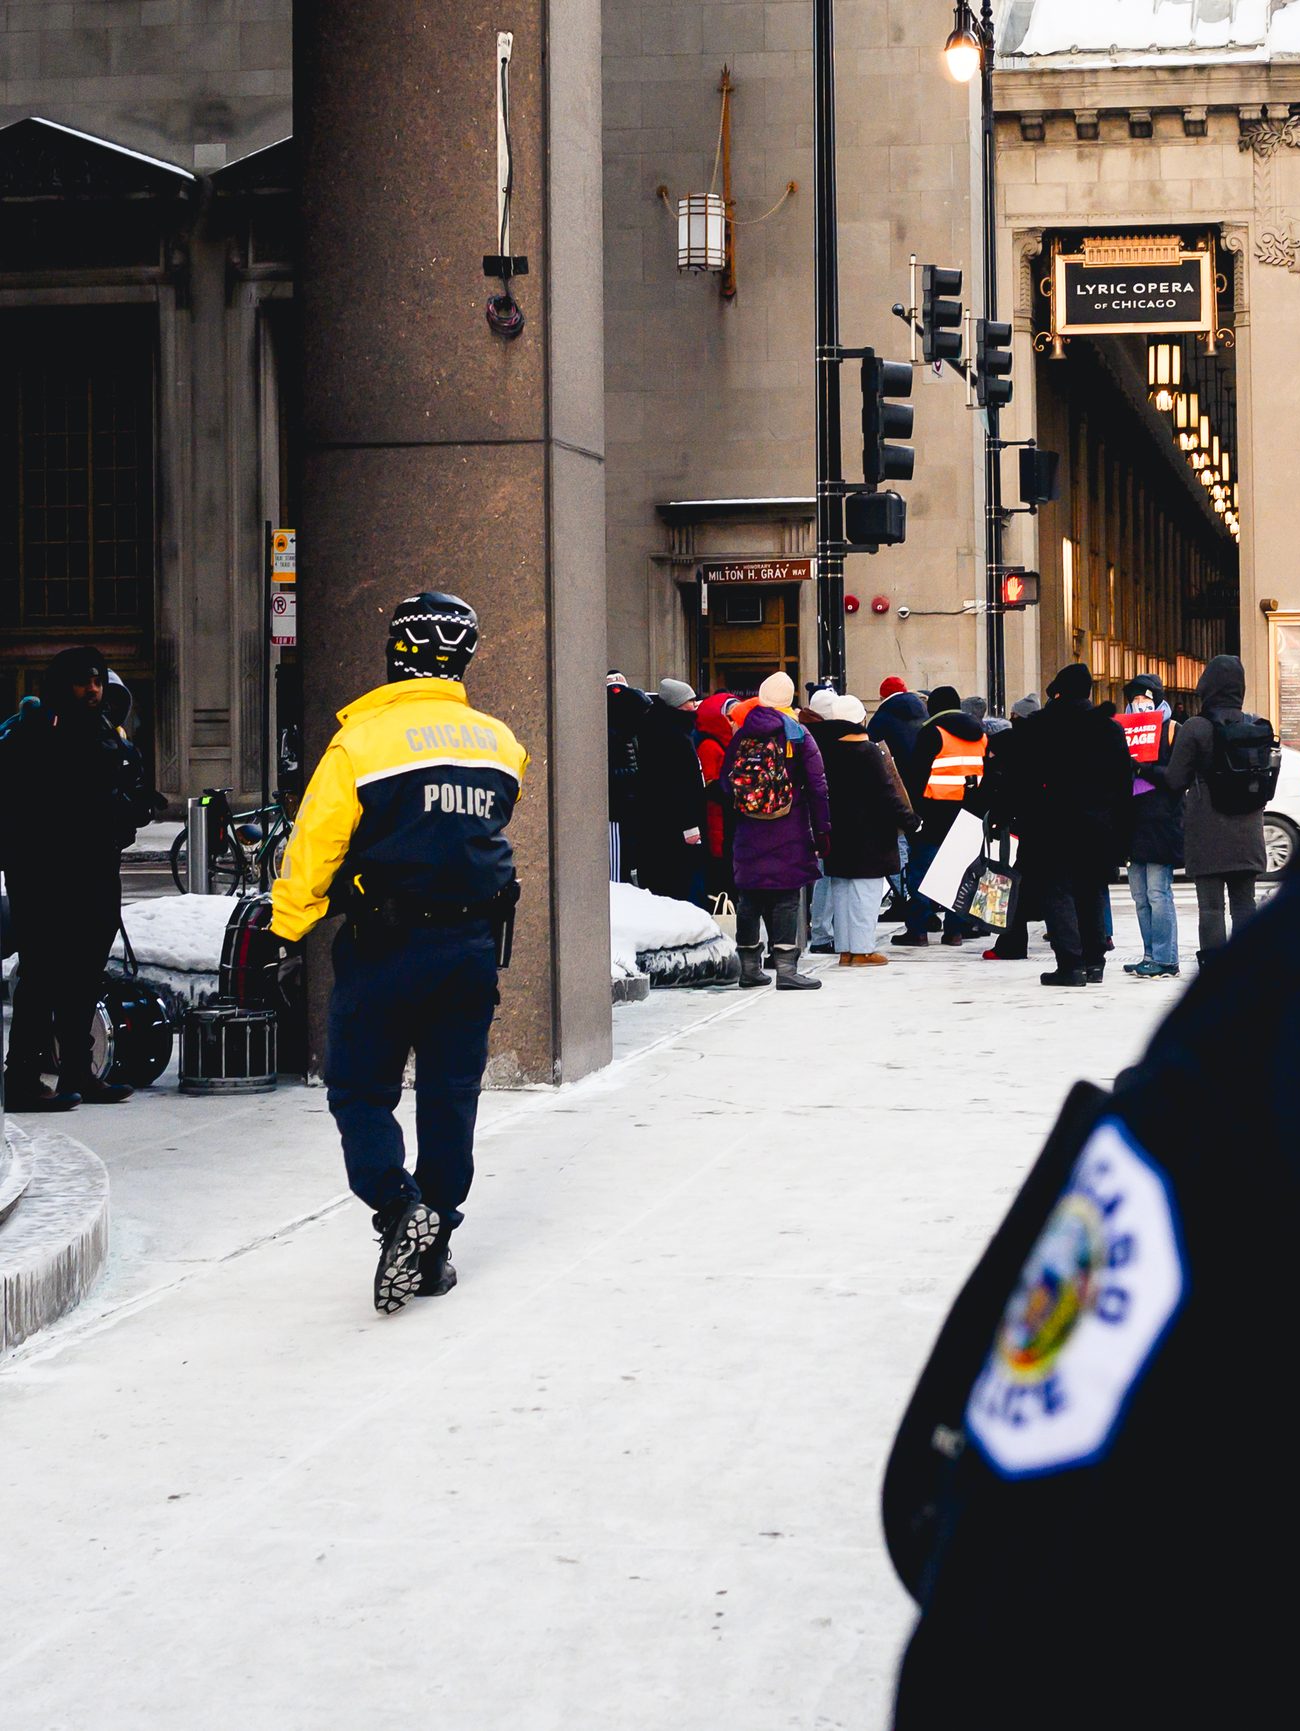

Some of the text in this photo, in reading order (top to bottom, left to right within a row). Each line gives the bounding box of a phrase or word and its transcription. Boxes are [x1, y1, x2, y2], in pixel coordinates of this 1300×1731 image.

[1076, 282, 1194, 295] LYRIC OPERA
[1112, 299, 1176, 309] CHICAGO
[708, 570, 744, 581] MILTON
[747, 569, 758, 580] H.
[761, 568, 788, 579] GRAY
[424, 783, 496, 820] POLICE
